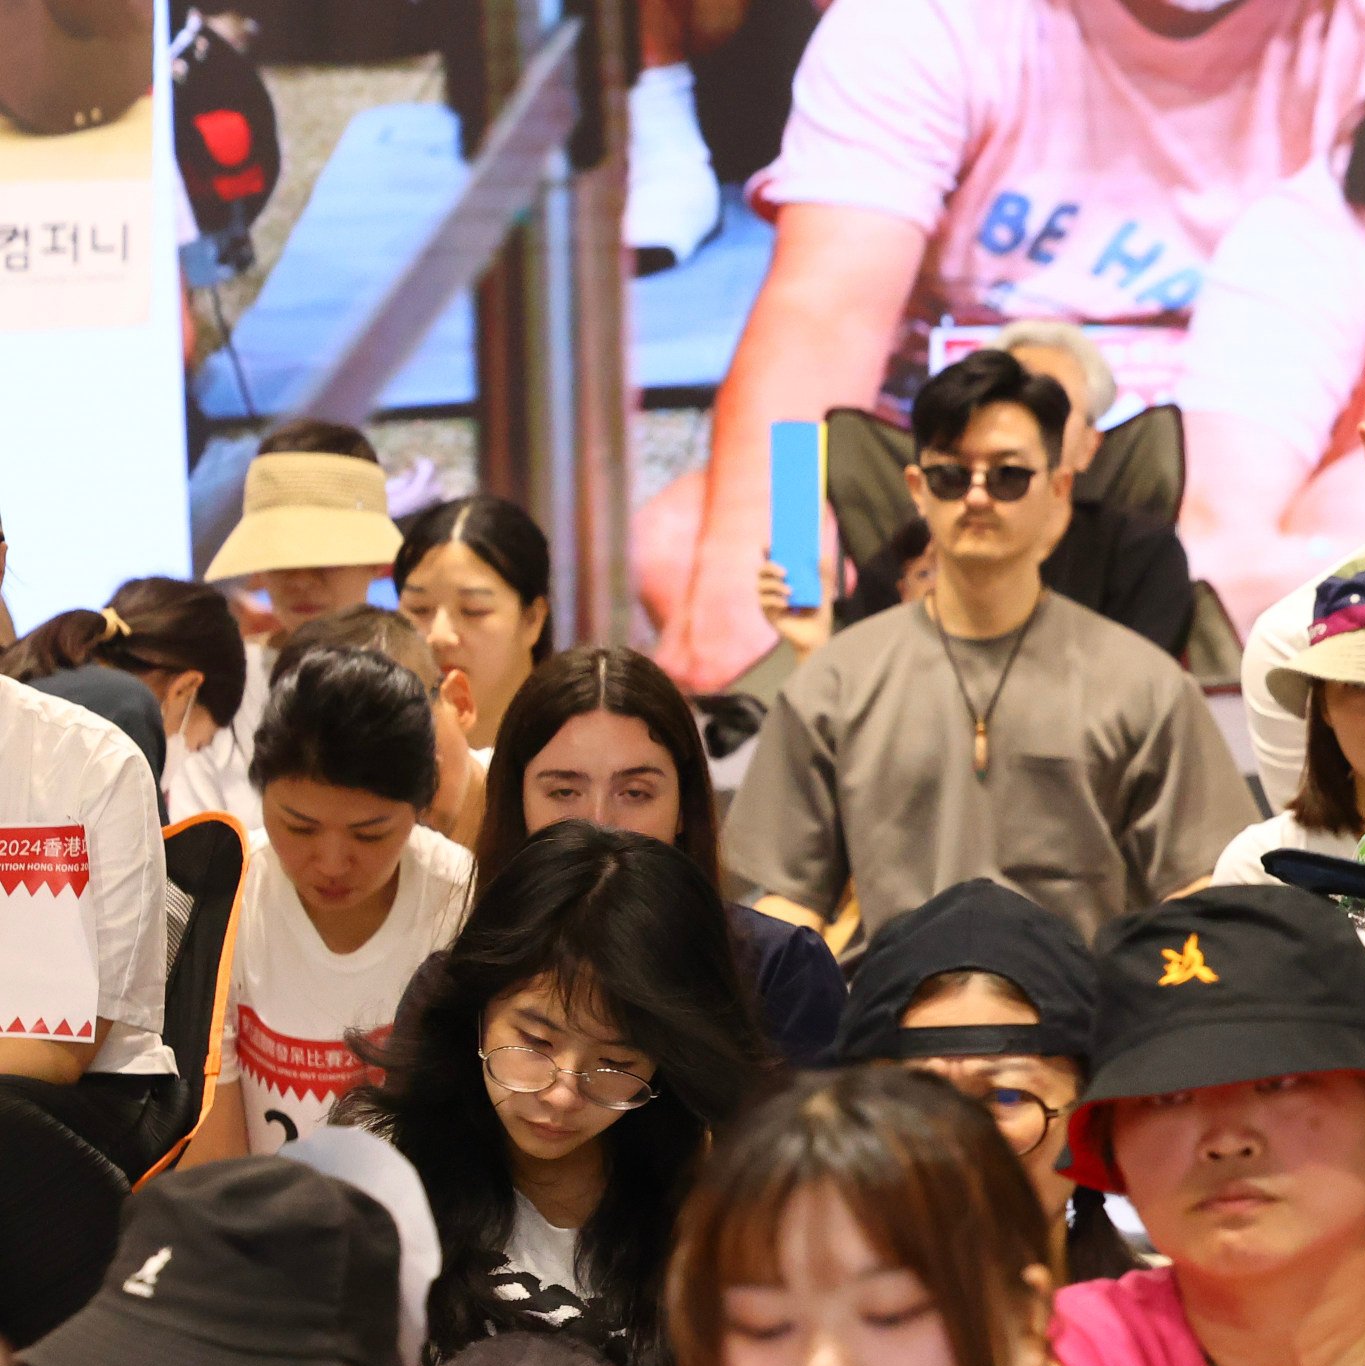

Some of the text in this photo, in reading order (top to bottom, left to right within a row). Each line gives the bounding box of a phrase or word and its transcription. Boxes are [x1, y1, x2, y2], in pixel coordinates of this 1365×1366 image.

[978, 191, 1081, 265] BE
[27, 862, 53, 872] HONG
[55, 863, 79, 873] KONG
